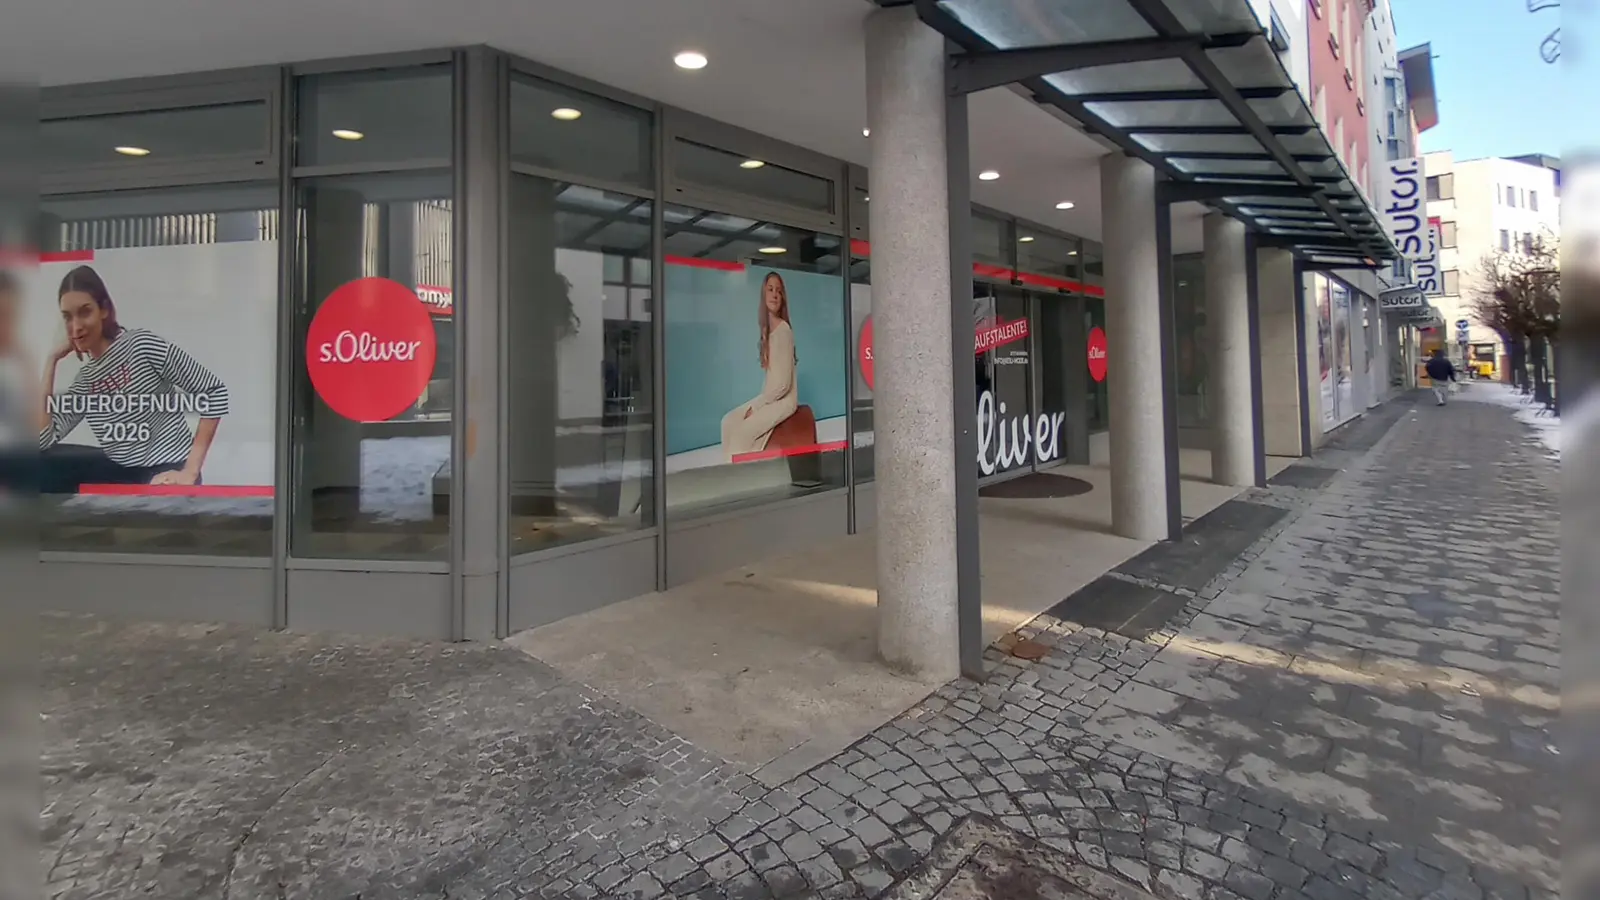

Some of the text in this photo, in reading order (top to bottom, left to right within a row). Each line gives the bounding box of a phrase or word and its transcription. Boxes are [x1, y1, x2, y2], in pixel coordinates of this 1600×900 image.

[1385, 160, 1422, 253] sutor.
[1413, 229, 1437, 291] sut.
[319, 330, 421, 364] s.Oliver
[974, 319, 1027, 350] AUFSTALENTE!
[46, 391, 211, 415] NEUERÖFFNUNG
[100, 422, 150, 442] 2026
[976, 390, 1065, 475] liver
